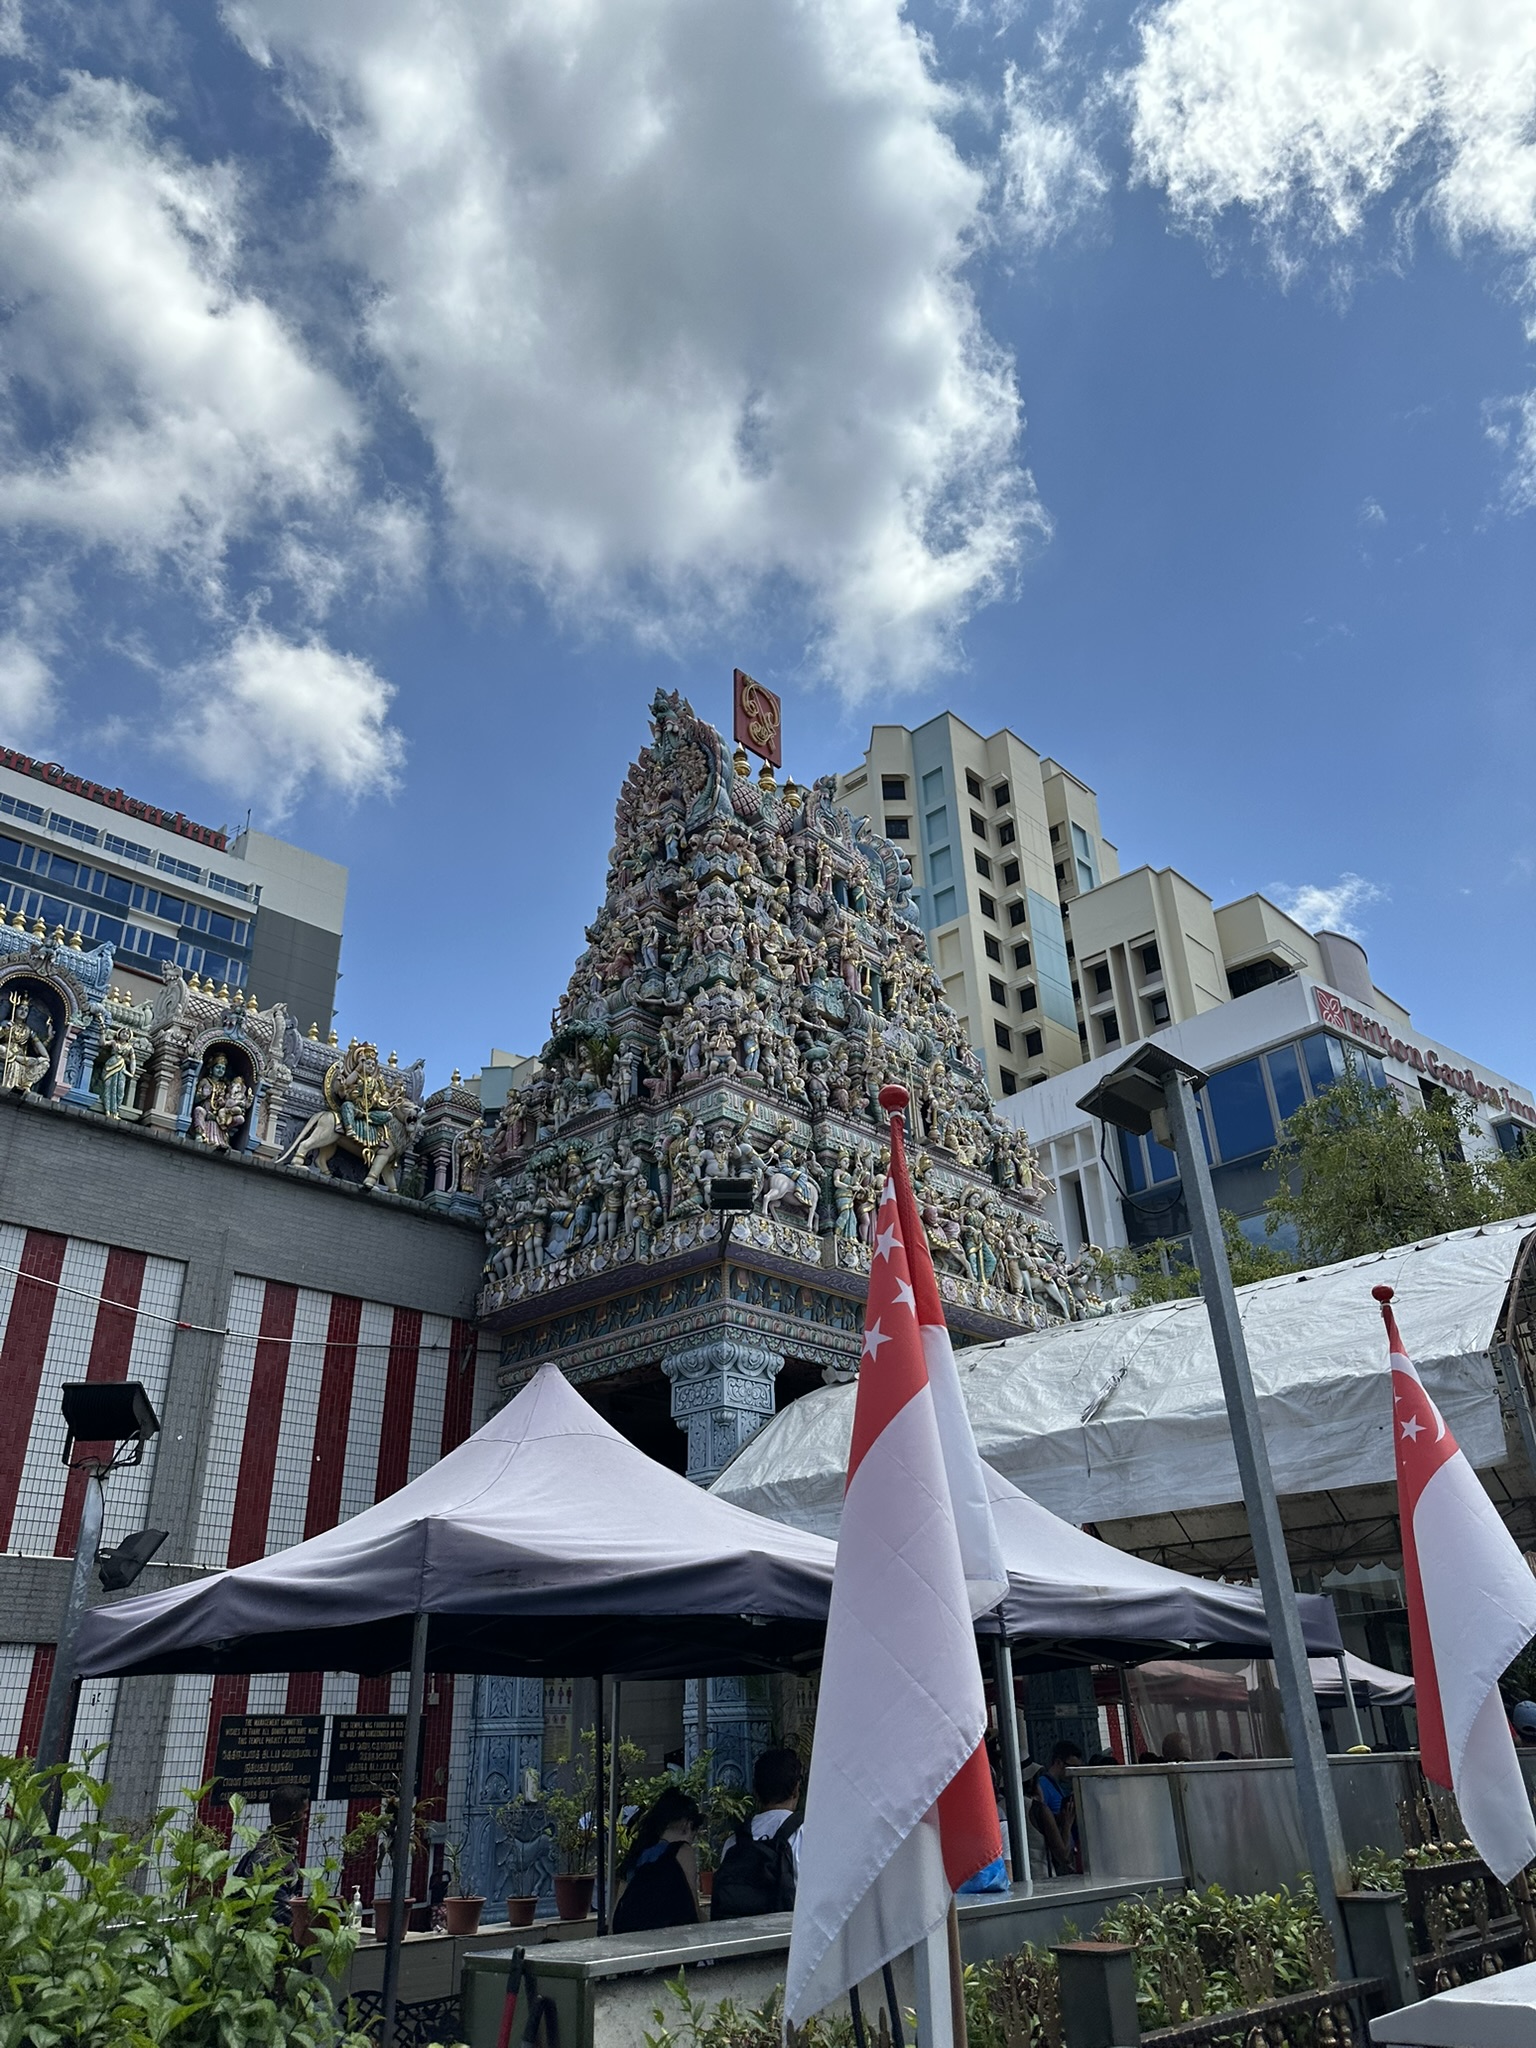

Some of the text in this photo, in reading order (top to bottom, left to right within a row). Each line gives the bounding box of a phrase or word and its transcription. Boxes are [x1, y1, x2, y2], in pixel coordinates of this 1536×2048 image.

[41, 761, 165, 828] Garden
[173, 810, 230, 852] Inn
[1342, 1005, 1427, 1074] Hilton
[1424, 1049, 1505, 1112] Garden
